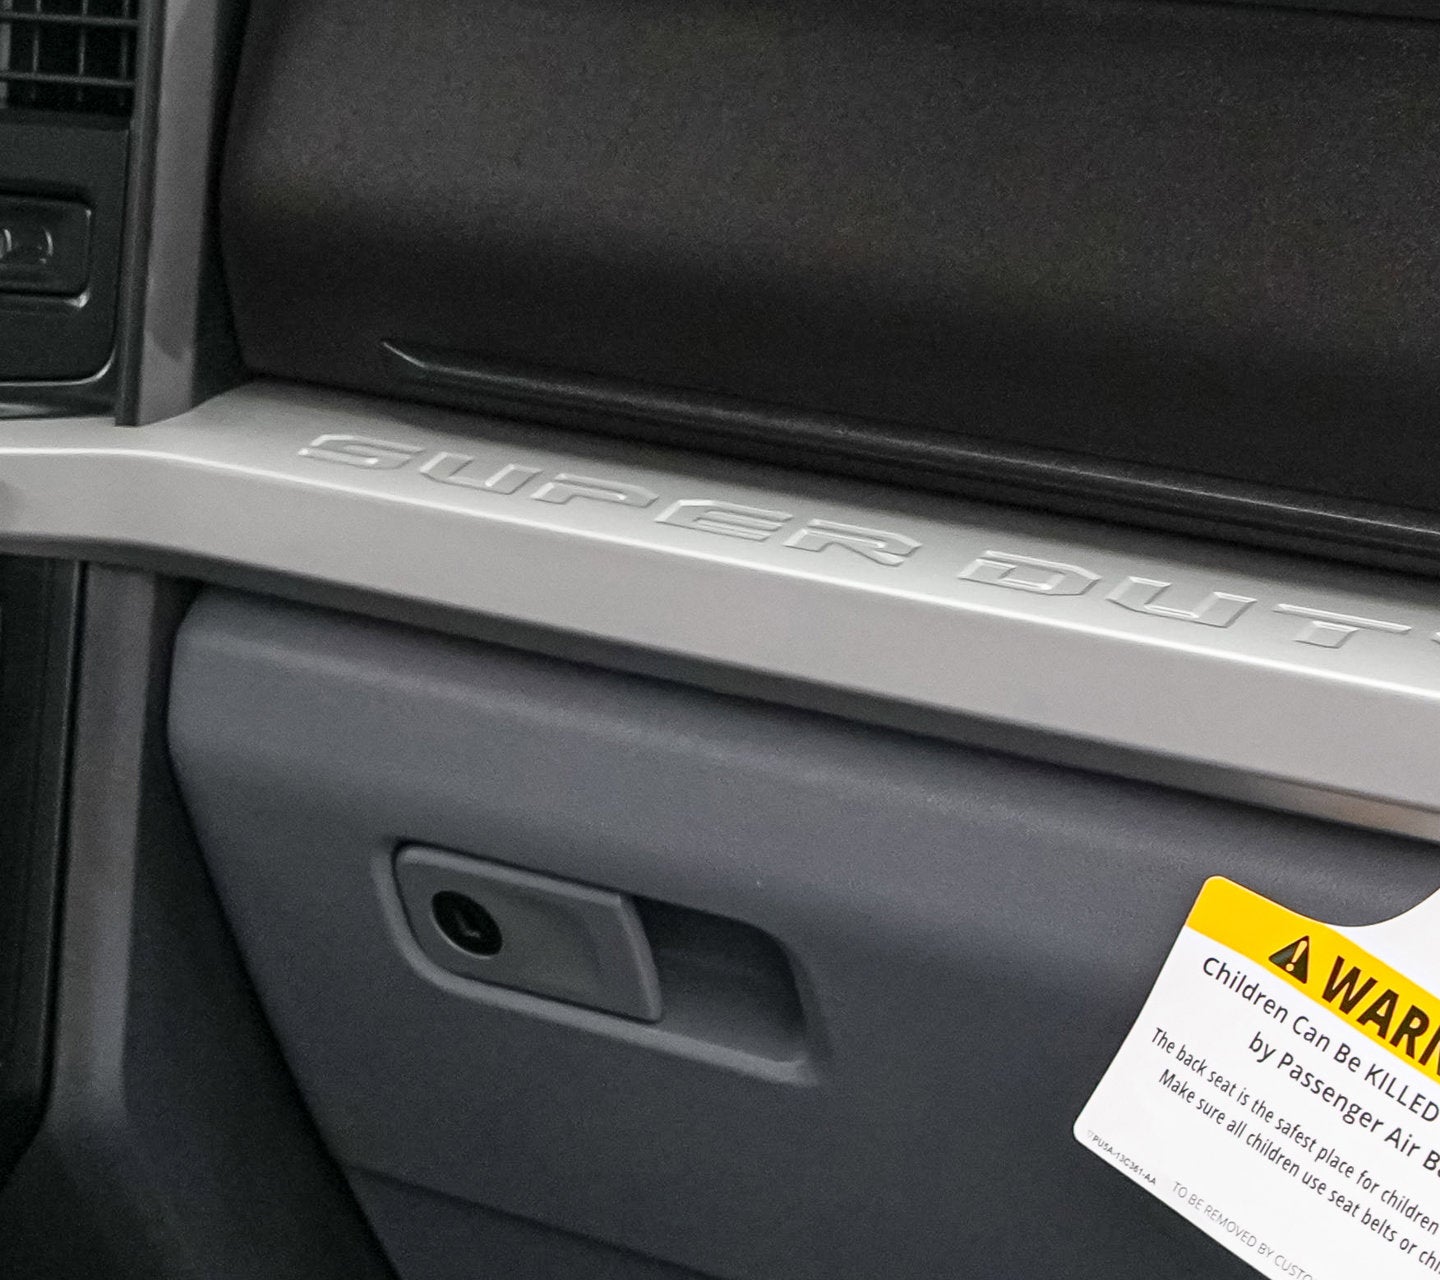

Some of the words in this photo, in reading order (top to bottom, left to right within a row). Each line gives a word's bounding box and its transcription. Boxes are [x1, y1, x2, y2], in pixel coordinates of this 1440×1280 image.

[298, 433, 922, 568] SUPER
[1202, 957, 1289, 1024] Children
[1292, 1015, 1331, 1053] Can
[1333, 1042, 1362, 1074] Be
[1364, 1063, 1440, 1123] KILLED
[1248, 1031, 1277, 1064] by
[1276, 1051, 1385, 1133] Passenger
[1383, 1127, 1422, 1158] Air
[1151, 1027, 1176, 1055] The
[1175, 1044, 1209, 1077] back
[1206, 1071, 1237, 1098] seat
[1236, 1087, 1251, 1107] is
[1250, 1099, 1275, 1124] the
[1274, 1118, 1318, 1153] safest
[1314, 1147, 1355, 1179] place
[1356, 1169, 1381, 1194] for
[1380, 1189, 1440, 1236] children
[1158, 1068, 1196, 1104] Make
[1195, 1098, 1226, 1126] sure
[1226, 1119, 1249, 1139] all
[1245, 1132, 1301, 1178] children
[1301, 1171, 1328, 1196] use
[1327, 1190, 1361, 1218] seat
[1360, 1207, 1398, 1243] belts
[1399, 1238, 1419, 1255] or
